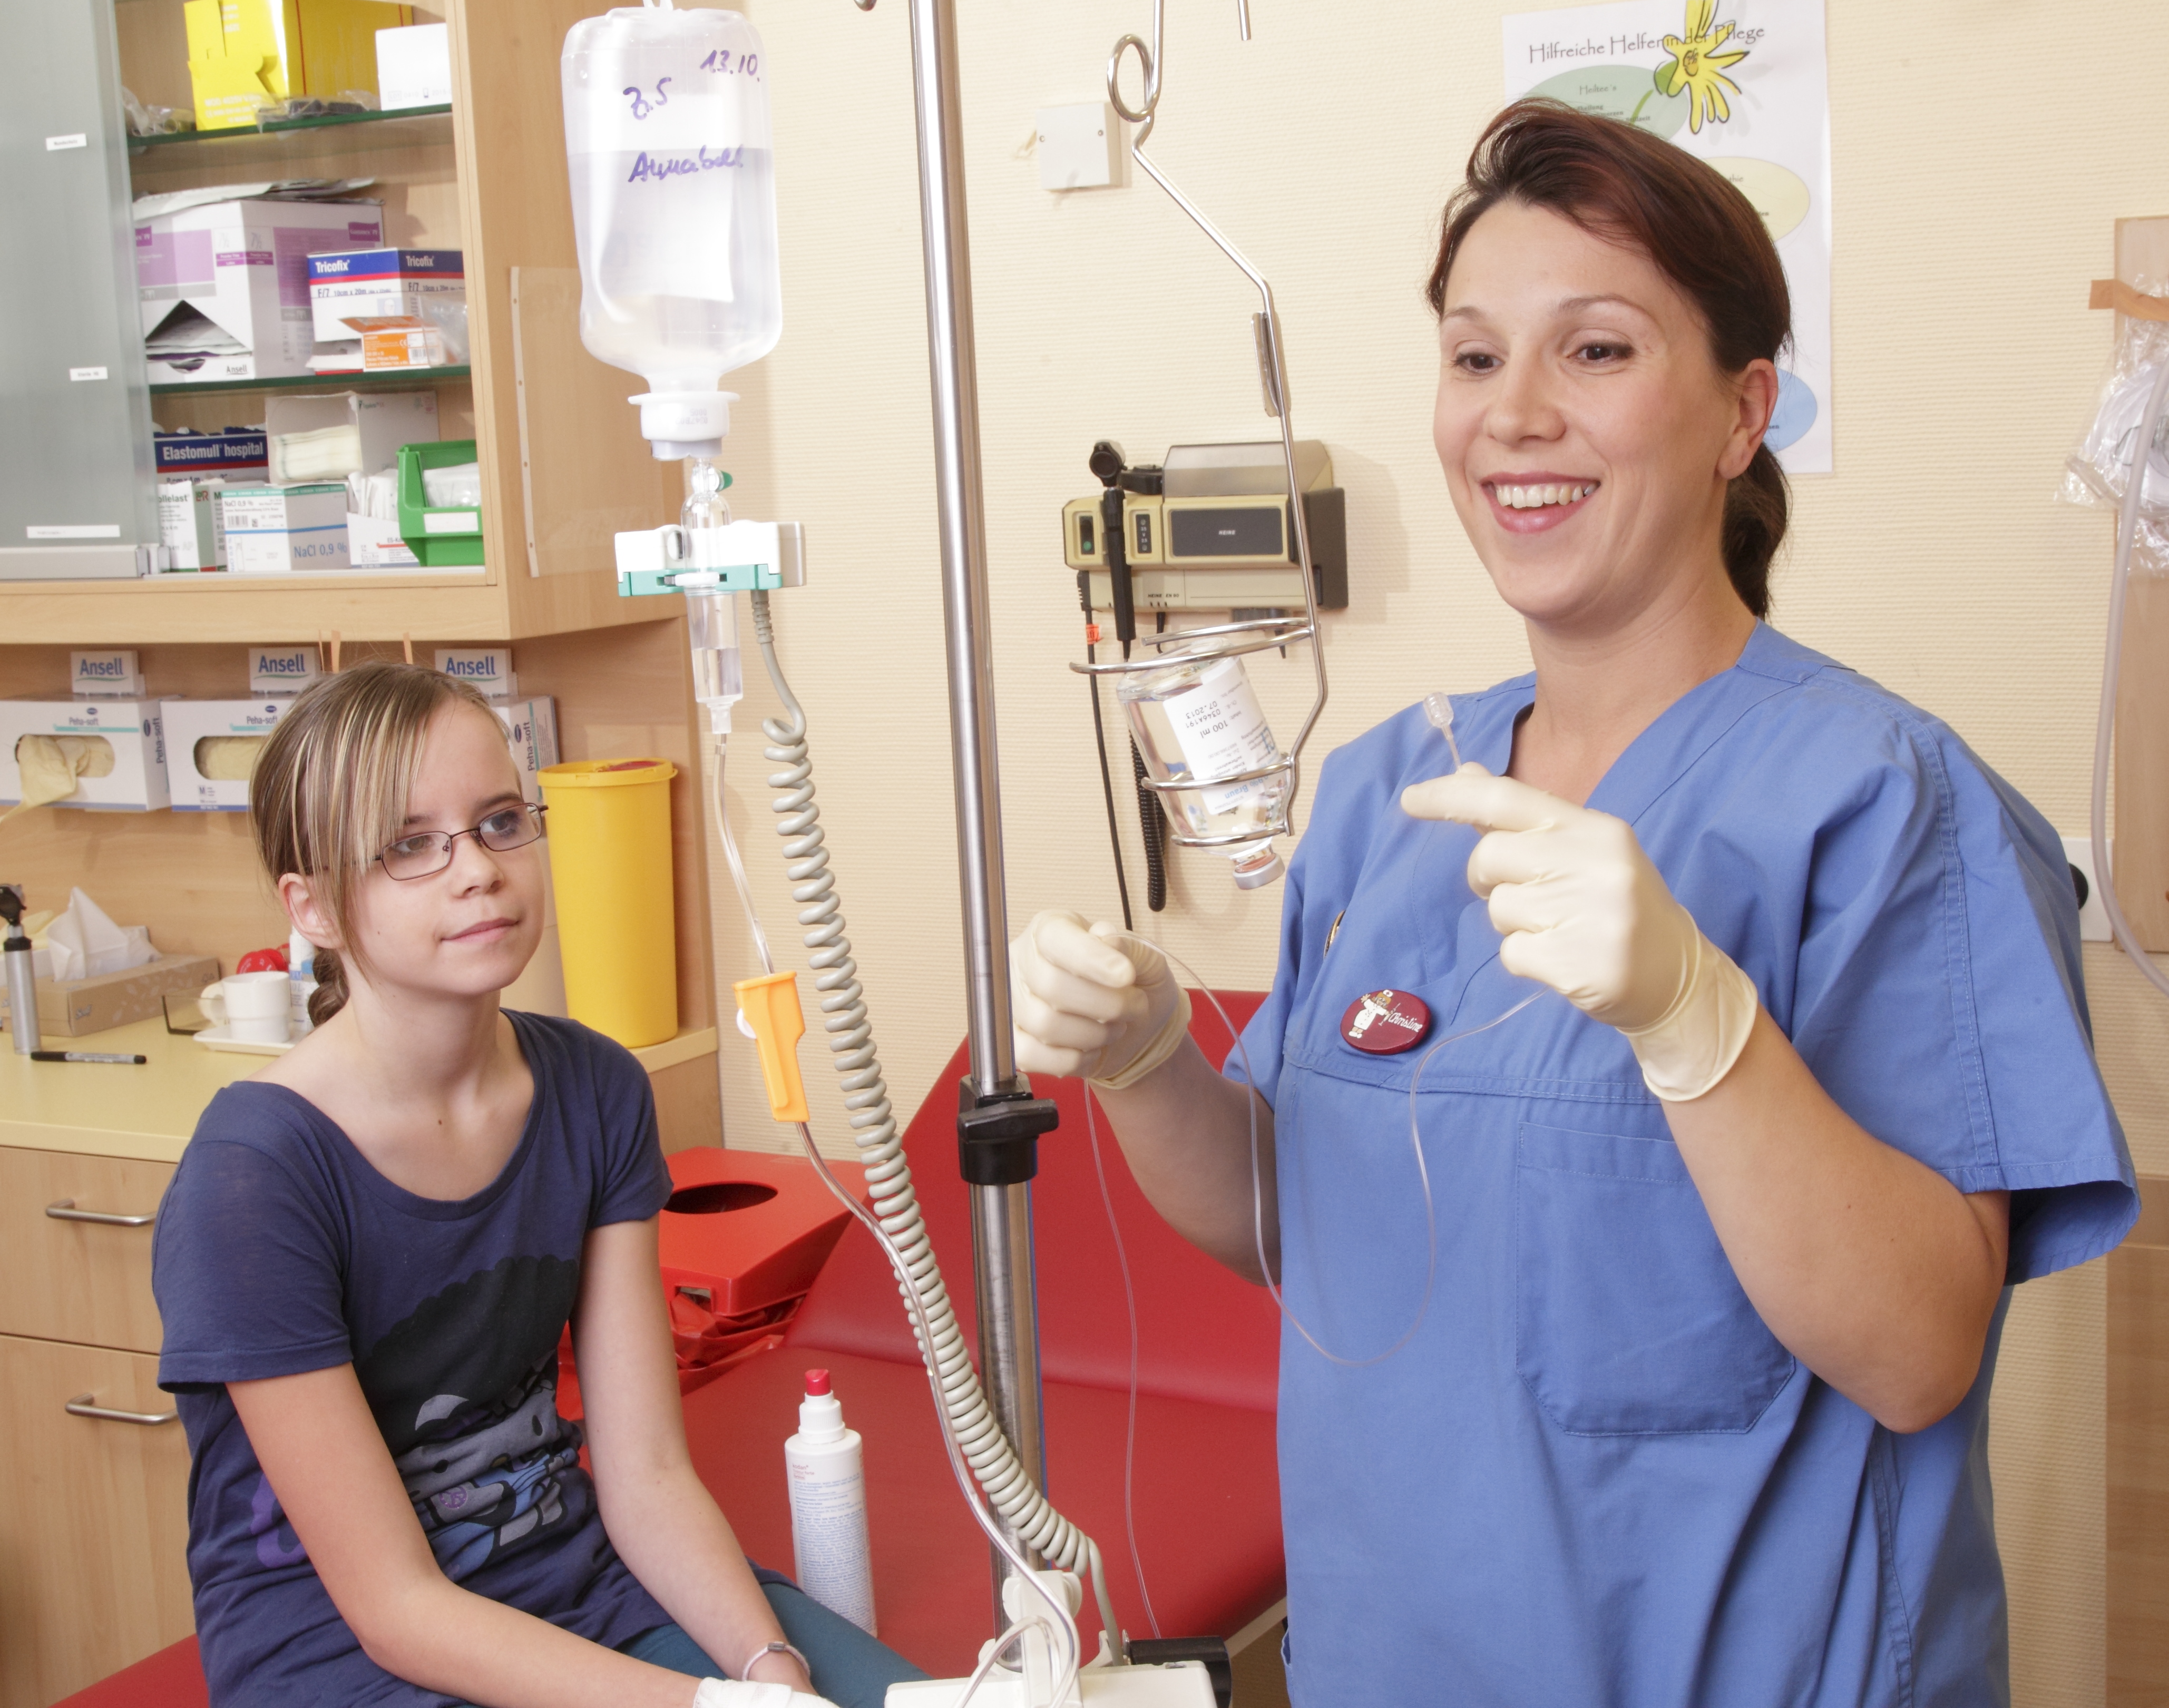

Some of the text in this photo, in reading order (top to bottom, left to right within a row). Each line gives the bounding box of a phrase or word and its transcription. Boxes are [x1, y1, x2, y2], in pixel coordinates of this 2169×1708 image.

[1529, 23, 1765, 64] Hilfreiche Helfer in der Pflege
[315, 261, 349, 273] Tricofix
[318, 288, 329, 298] F/7
[227, 364, 248, 374] Ansell
[162, 441, 263, 460] Elastomull hospital
[294, 544, 316, 558] NaCl
[319, 543, 334, 556] 0,9
[337, 542, 347, 553] %
[80, 657, 123, 676] Ansell
[258, 654, 305, 673] Ansell
[446, 656, 496, 675] Ansell
[1185, 709, 1221, 729] 0346A191
[1186, 701, 1217, 720] 07.2013
[69, 716, 99, 725] Peha-soft
[1213, 720, 1229, 732] 100
[152, 717, 164, 764] Peha-soft
[1200, 728, 1211, 739] ml
[523, 721, 536, 772] Peha-soft
[1225, 784, 1249, 799] Braun
[1388, 1012, 1423, 1033] Christine
